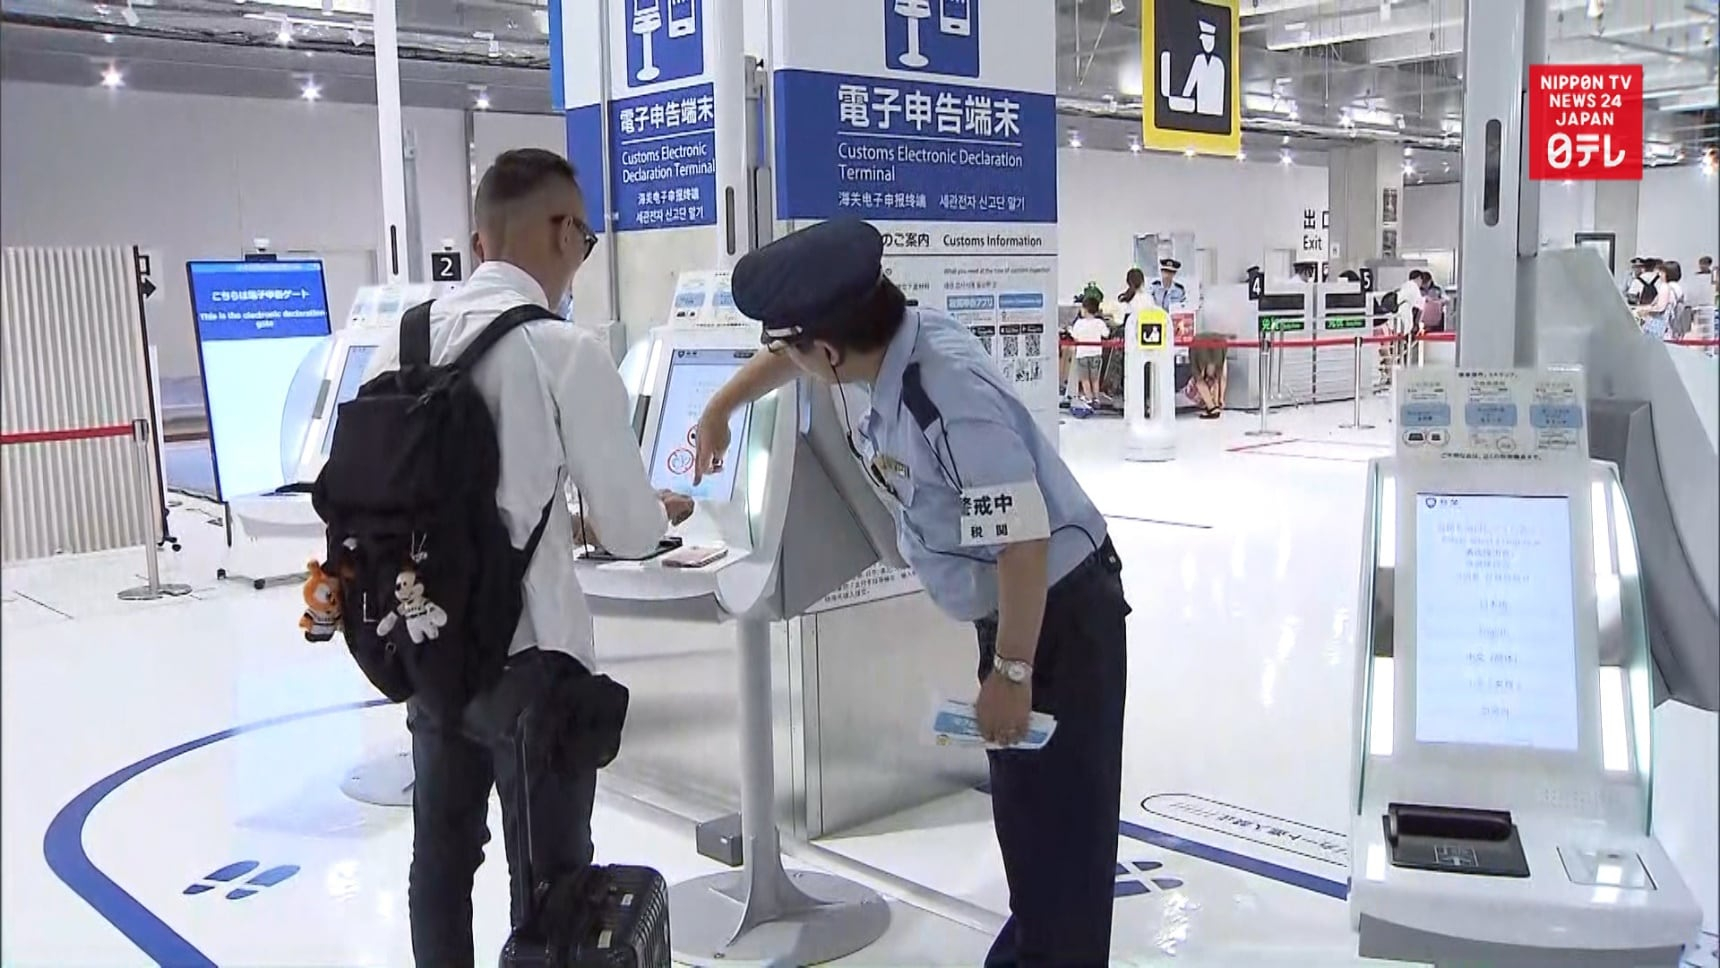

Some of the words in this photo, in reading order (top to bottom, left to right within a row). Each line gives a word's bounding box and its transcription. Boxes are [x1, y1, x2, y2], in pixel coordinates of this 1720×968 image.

[620, 95, 714, 134] 電子申告端末
[838, 84, 1020, 137] 電子申告端末
[622, 151, 660, 165] Customs
[661, 142, 707, 160] Electronic
[838, 143, 895, 161] Customs
[898, 146, 957, 165] Electronic
[960, 149, 1023, 167] Declaration
[623, 165, 673, 183] Declaration
[674, 159, 716, 177] Terminal
[838, 164, 896, 181] Terminal
[838, 191, 927, 209] 海关电子申报终端
[943, 234, 985, 248] Customs
[987, 234, 1042, 248] Information
[1303, 235, 1322, 250] Exit
[440, 257, 454, 276] 2
[1253, 277, 1261, 296] 4
[1363, 271, 1371, 289] 5
[200, 312, 217, 320] This
[227, 311, 241, 320] the
